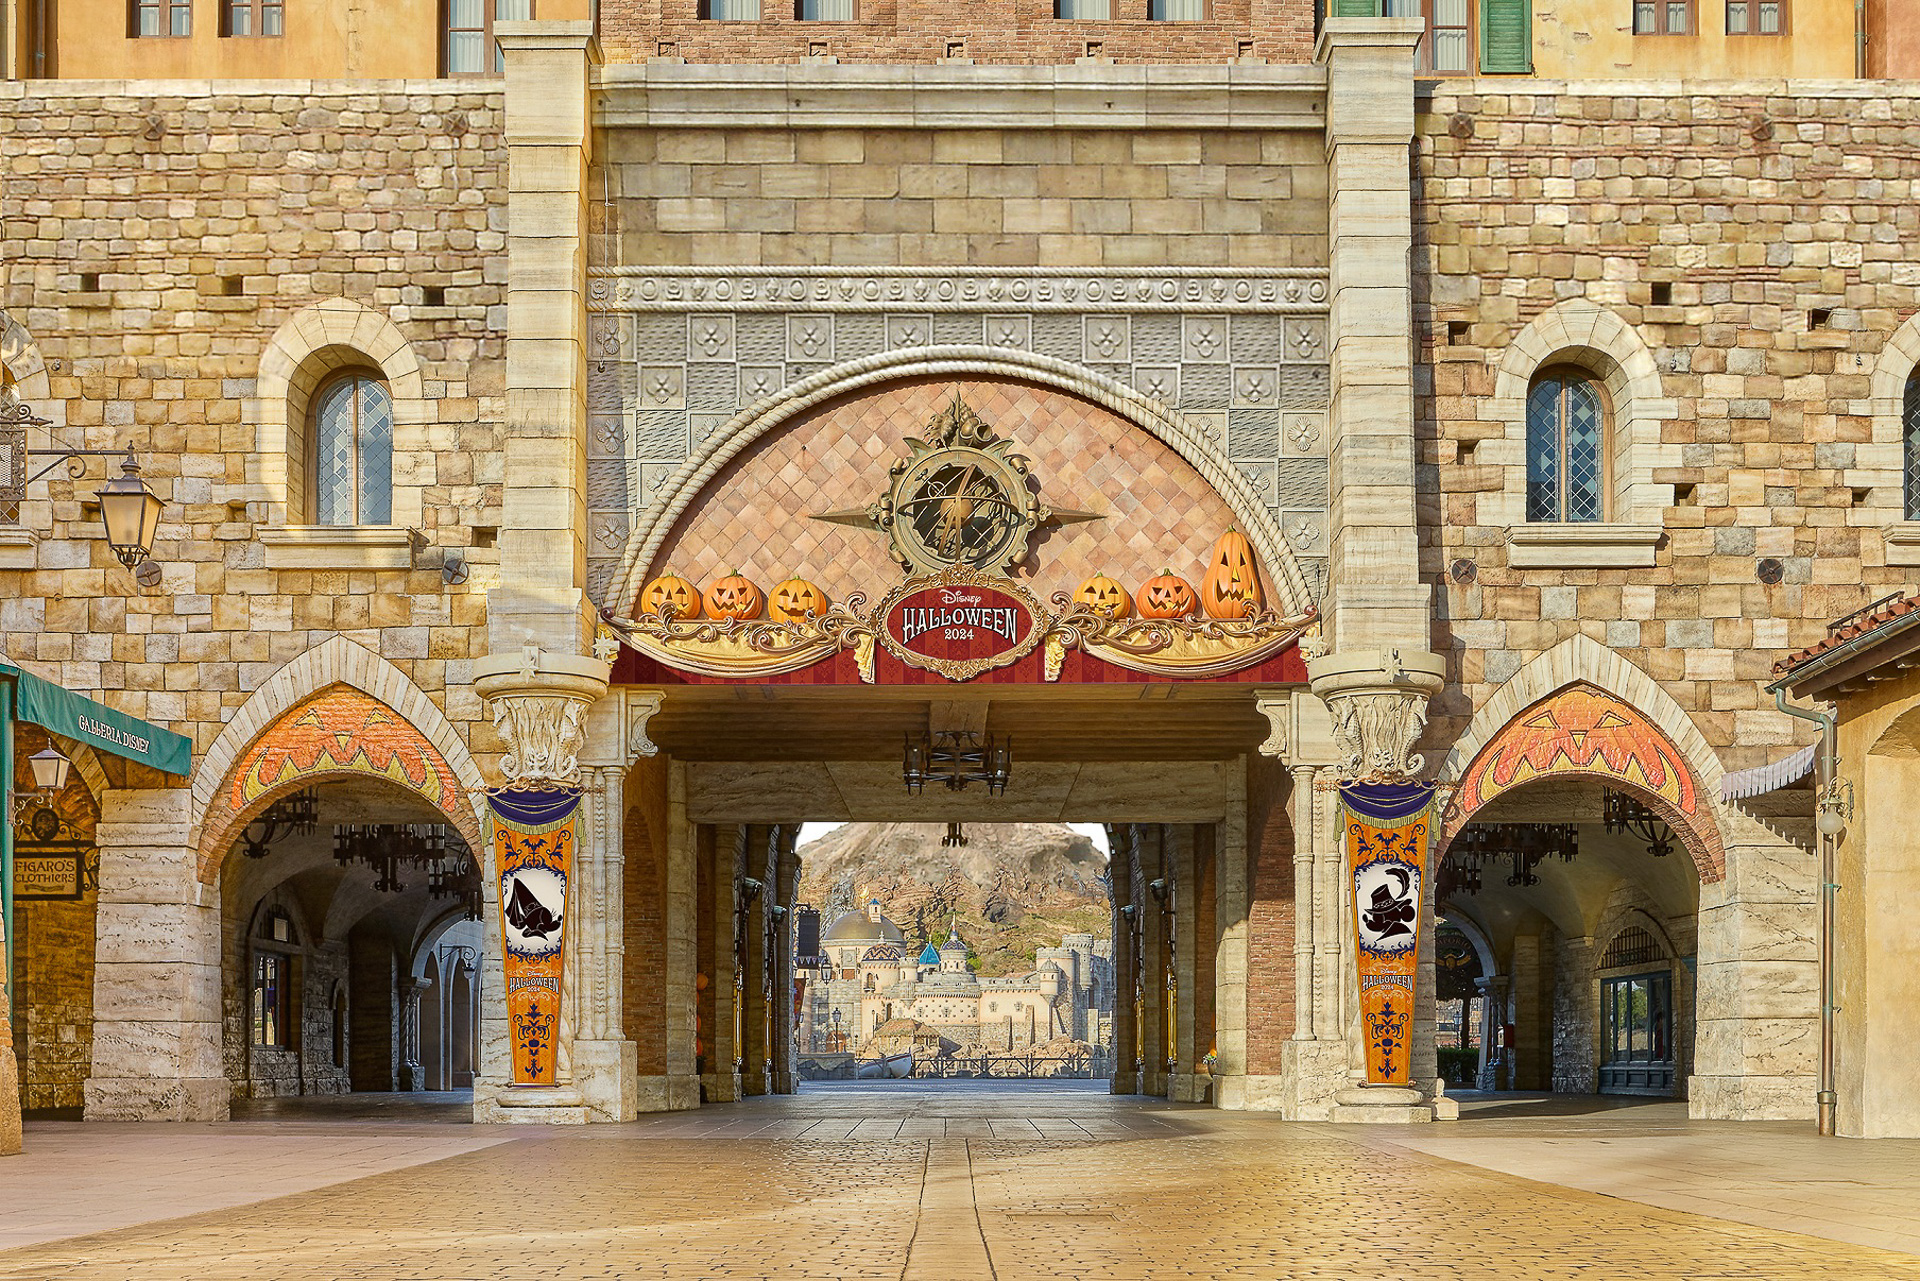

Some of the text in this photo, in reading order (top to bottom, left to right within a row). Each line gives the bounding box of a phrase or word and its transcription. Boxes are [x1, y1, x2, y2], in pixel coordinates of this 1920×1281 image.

[939, 589, 982, 607] Disney
[902, 608, 1018, 646] HALLOWEEN
[944, 628, 975, 640] 2024
[78, 714, 151, 755] GALLERIA DISNEY
[14, 860, 75, 873] FIGARO'S
[14, 873, 75, 883] CLOTHIERS
[509, 977, 559, 994] HALLOWEEN
[1362, 975, 1413, 992] HALLOWEEN
